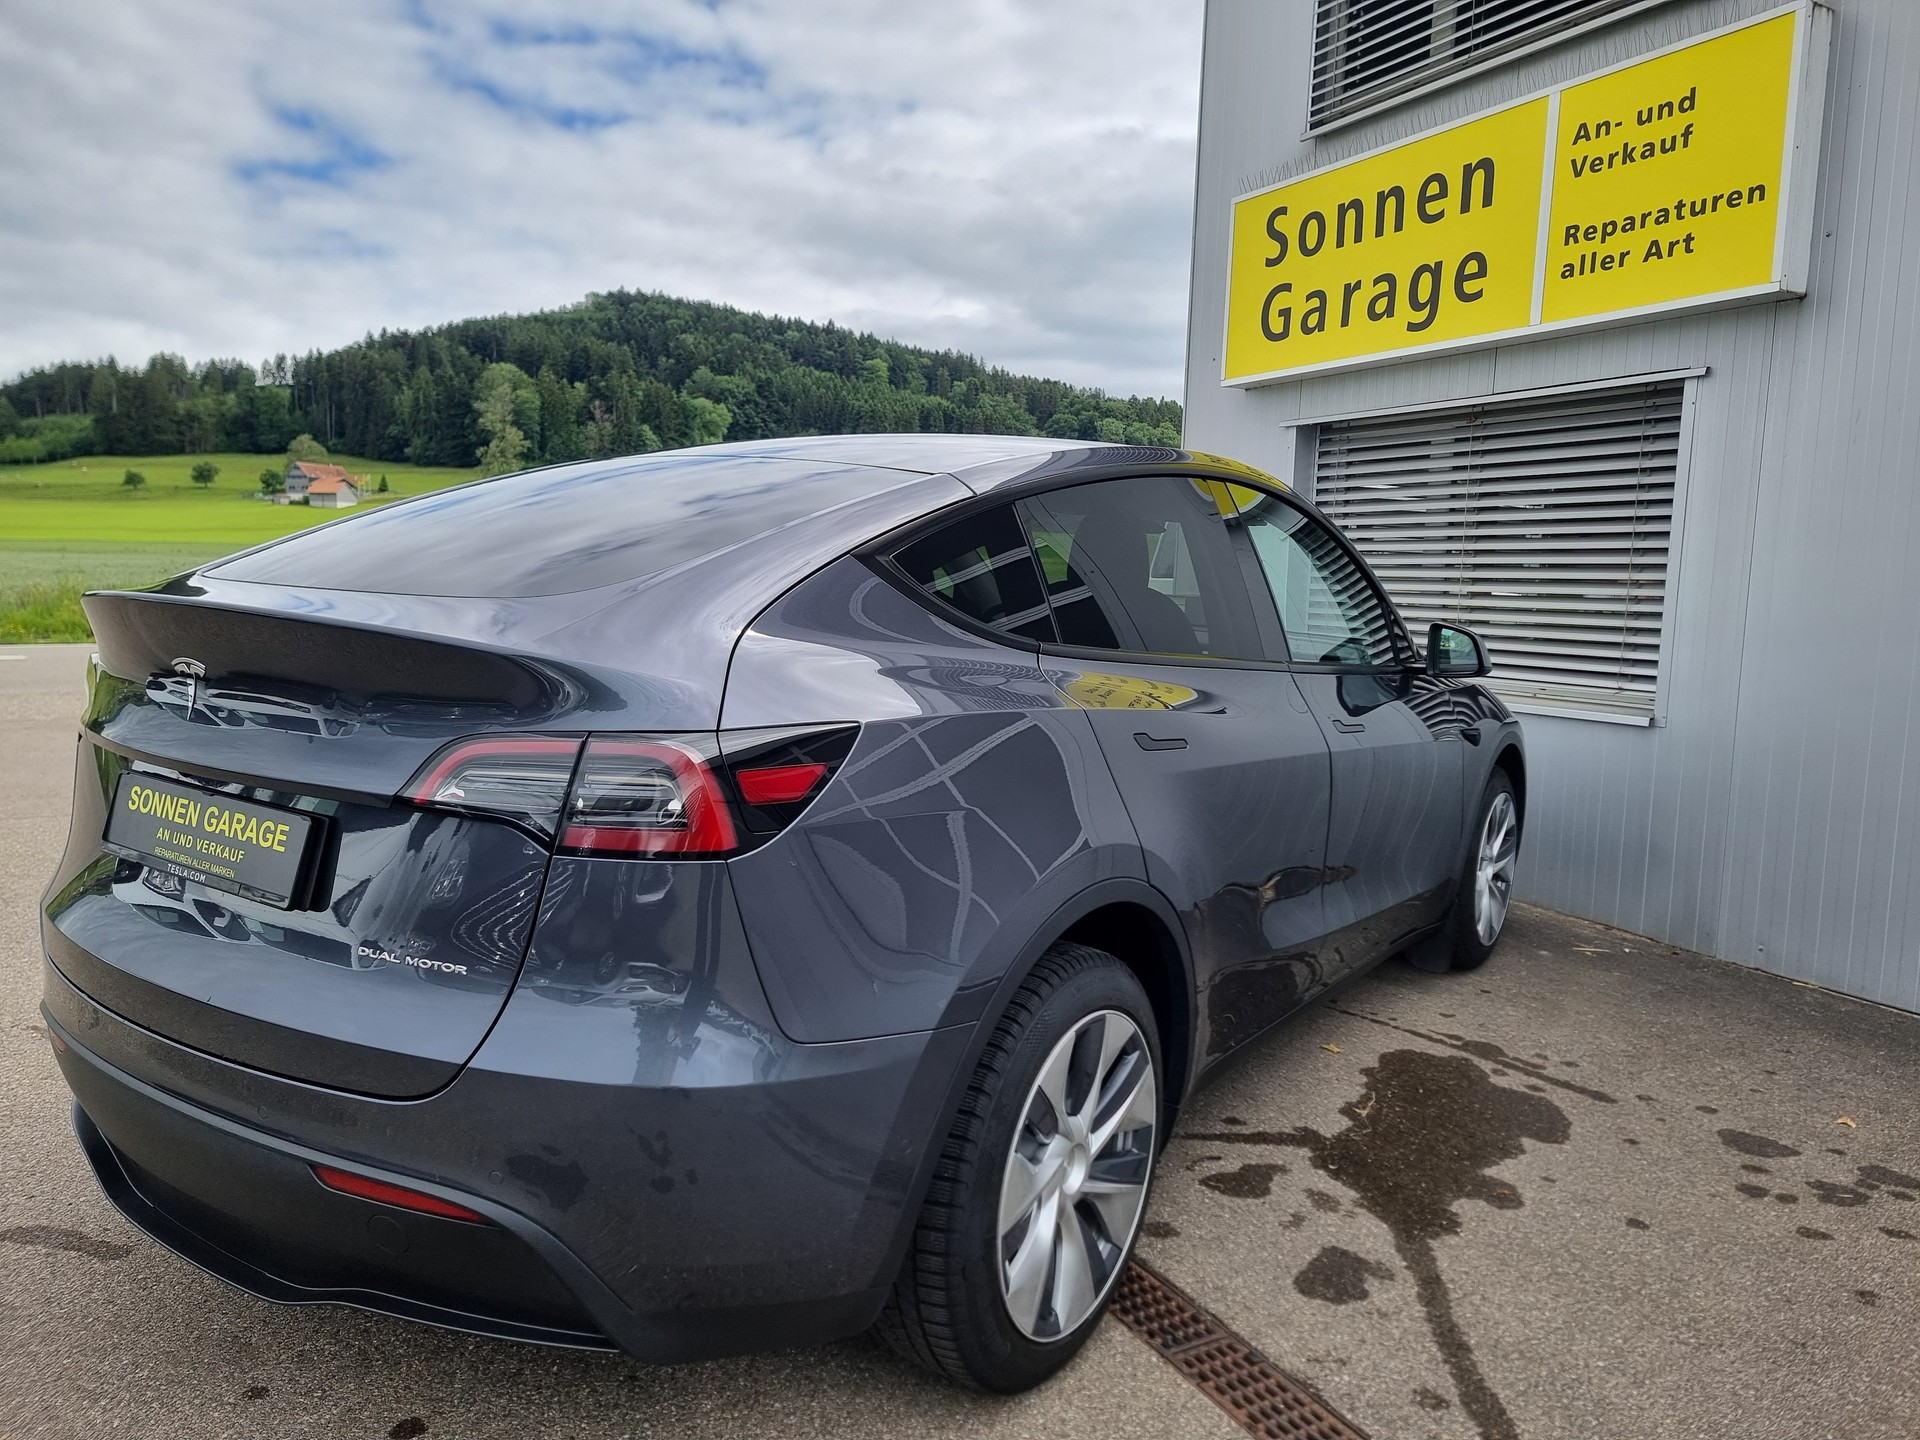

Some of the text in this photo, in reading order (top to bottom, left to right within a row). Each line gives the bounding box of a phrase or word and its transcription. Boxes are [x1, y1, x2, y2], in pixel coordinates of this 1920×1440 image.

[1571, 87, 1697, 147] An- und
[1570, 122, 1694, 179] Verkauf
[1264, 156, 1496, 268] Sonnen
[1563, 183, 1767, 247] Reparaturen
[1560, 231, 1696, 280] aller Art
[1260, 251, 1488, 342] Garage
[128, 785, 290, 852] SONNEN GARAGE
[156, 827, 246, 864] AN UND VERKAUF
[154, 846, 236, 879] REPARATUREN ALLER MARKEN
[167, 863, 206, 883] TESLA.COM
[357, 946, 468, 975] DUAL MOTOR
